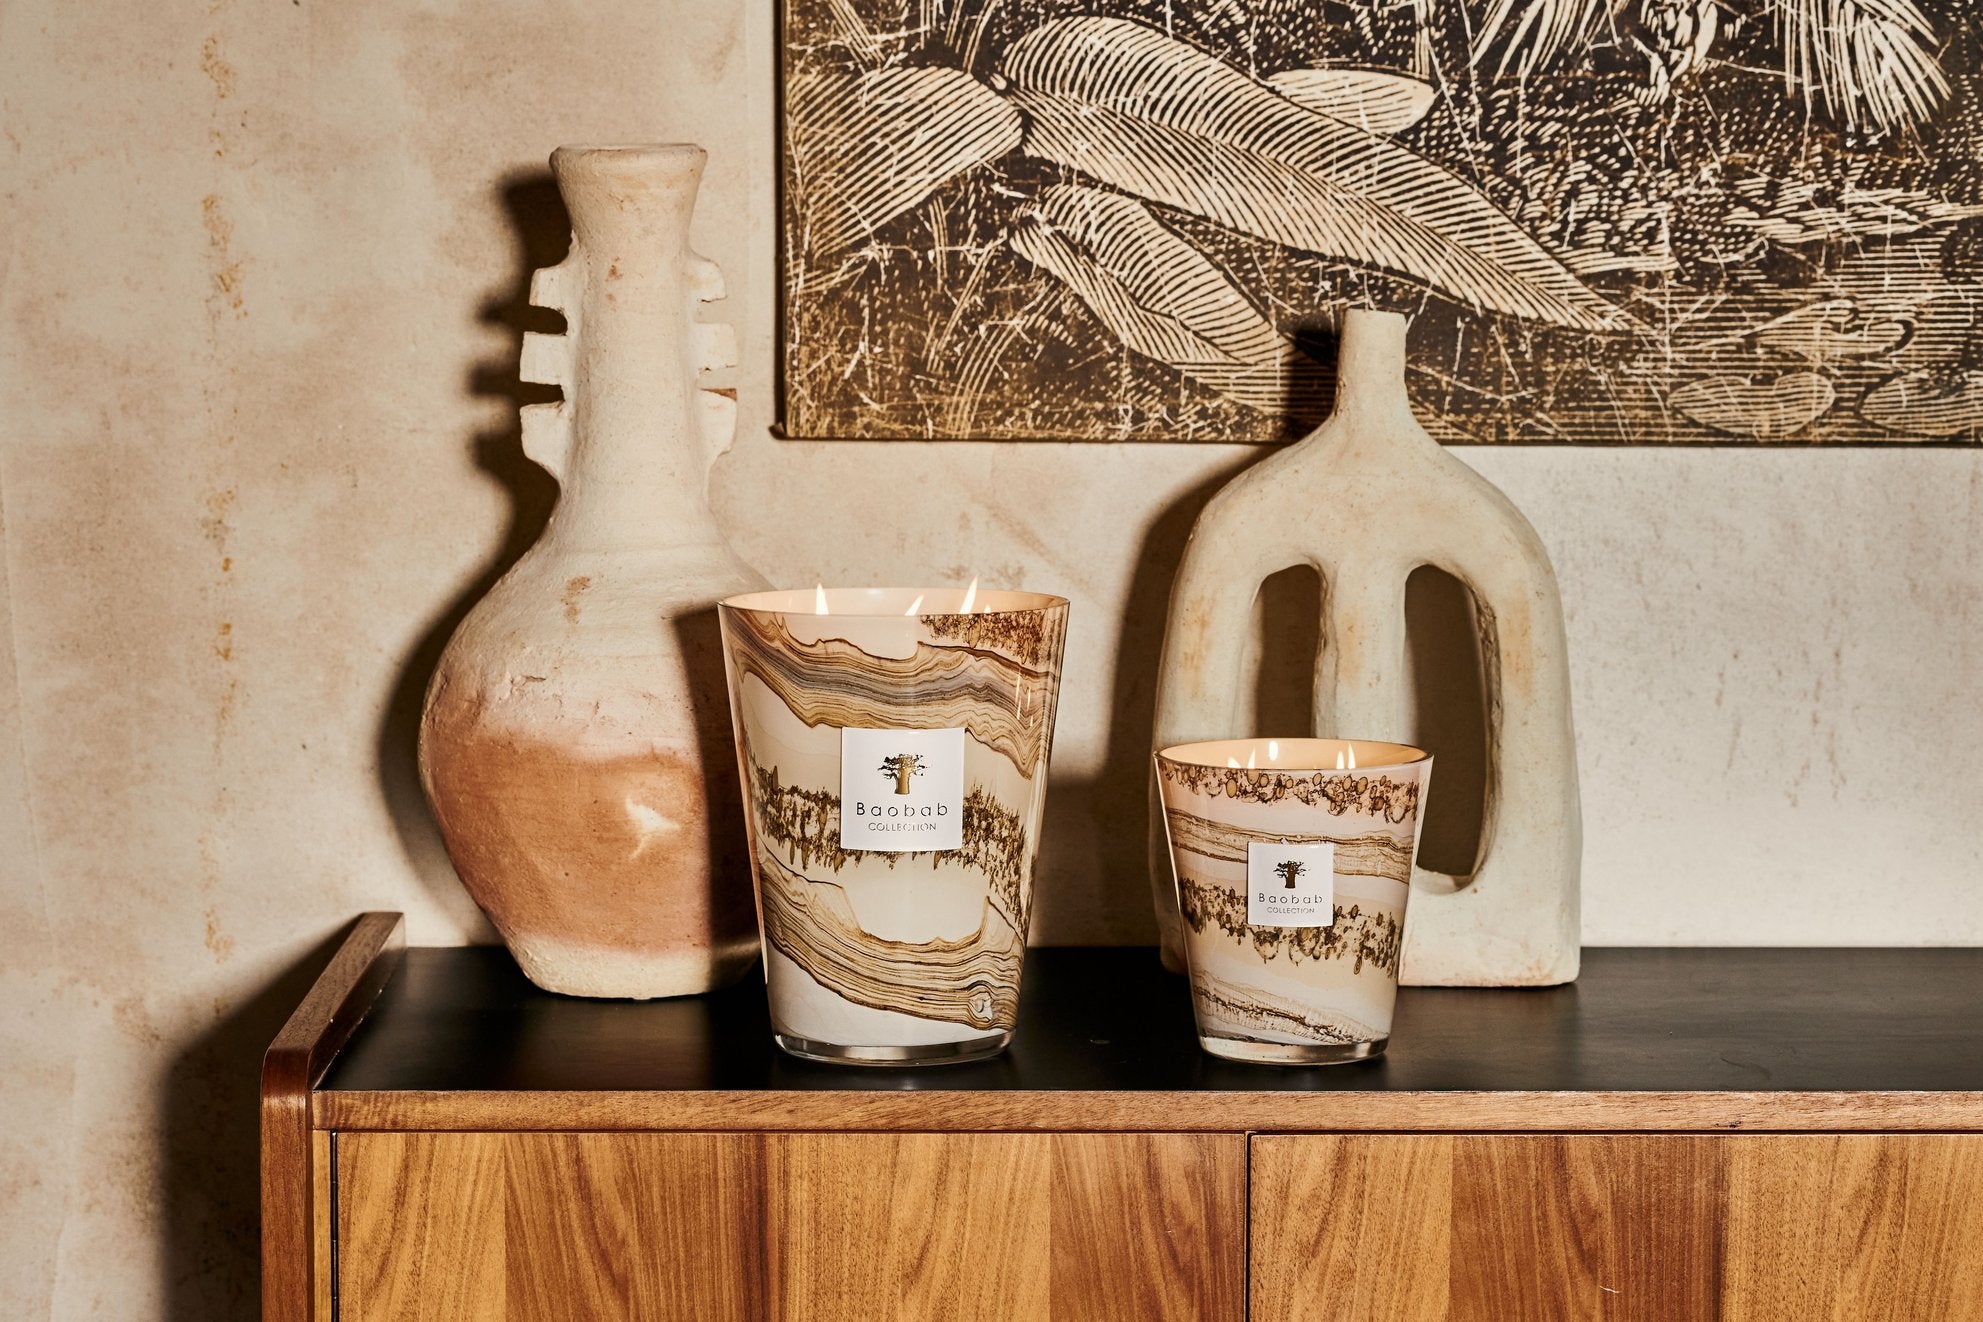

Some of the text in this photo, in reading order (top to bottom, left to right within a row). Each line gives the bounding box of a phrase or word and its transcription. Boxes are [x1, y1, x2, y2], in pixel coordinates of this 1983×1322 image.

[856, 801, 948, 817] Baobab
[868, 822, 937, 832] COLLECTION
[1258, 892, 1323, 904] Baobab
[1266, 906, 1315, 914] COLLECTION
